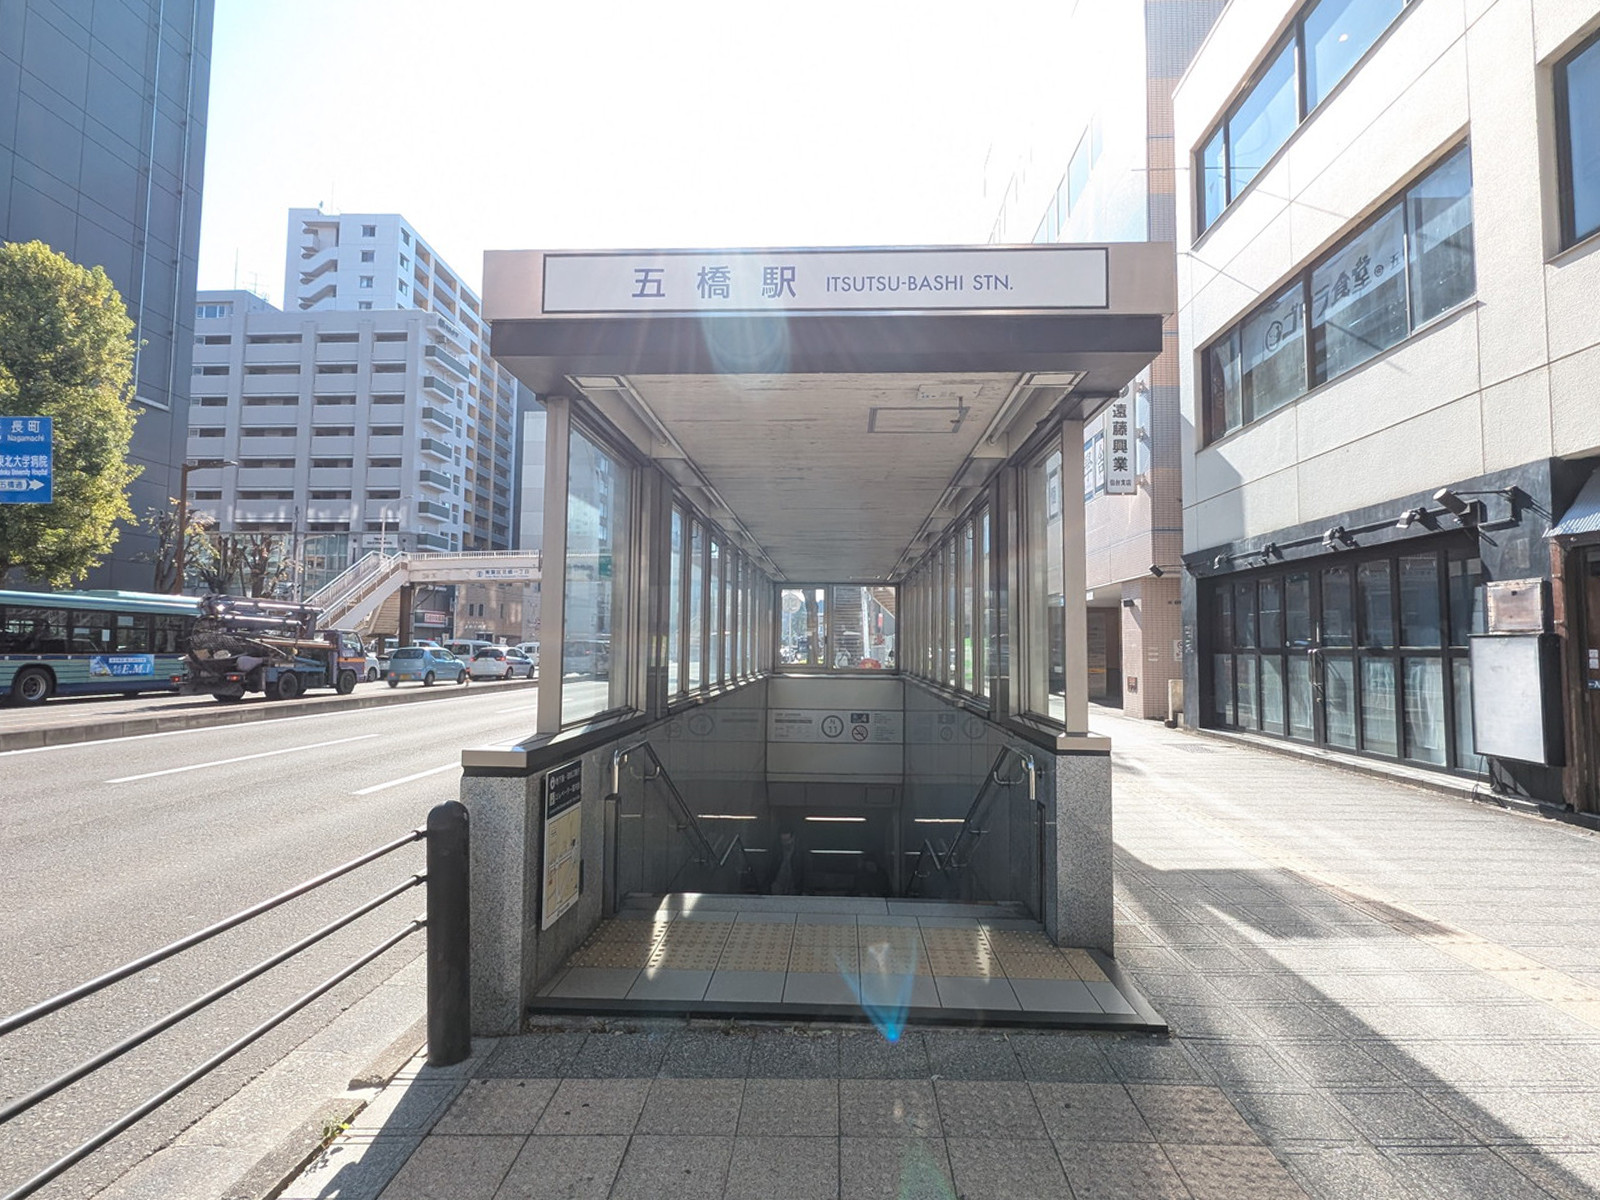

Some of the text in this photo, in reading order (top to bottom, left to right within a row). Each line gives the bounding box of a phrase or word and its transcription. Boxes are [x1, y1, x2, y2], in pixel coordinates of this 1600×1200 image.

[632, 265, 797, 299] 五橋駅
[826, 274, 1014, 292] ITSUTSU-BASHI STN.
[11, 420, 40, 433] 長町
[7, 434, 45, 443] Nagamachi
[1112, 403, 1128, 472] 遠藤興業
[828, 725, 838, 733] 11
